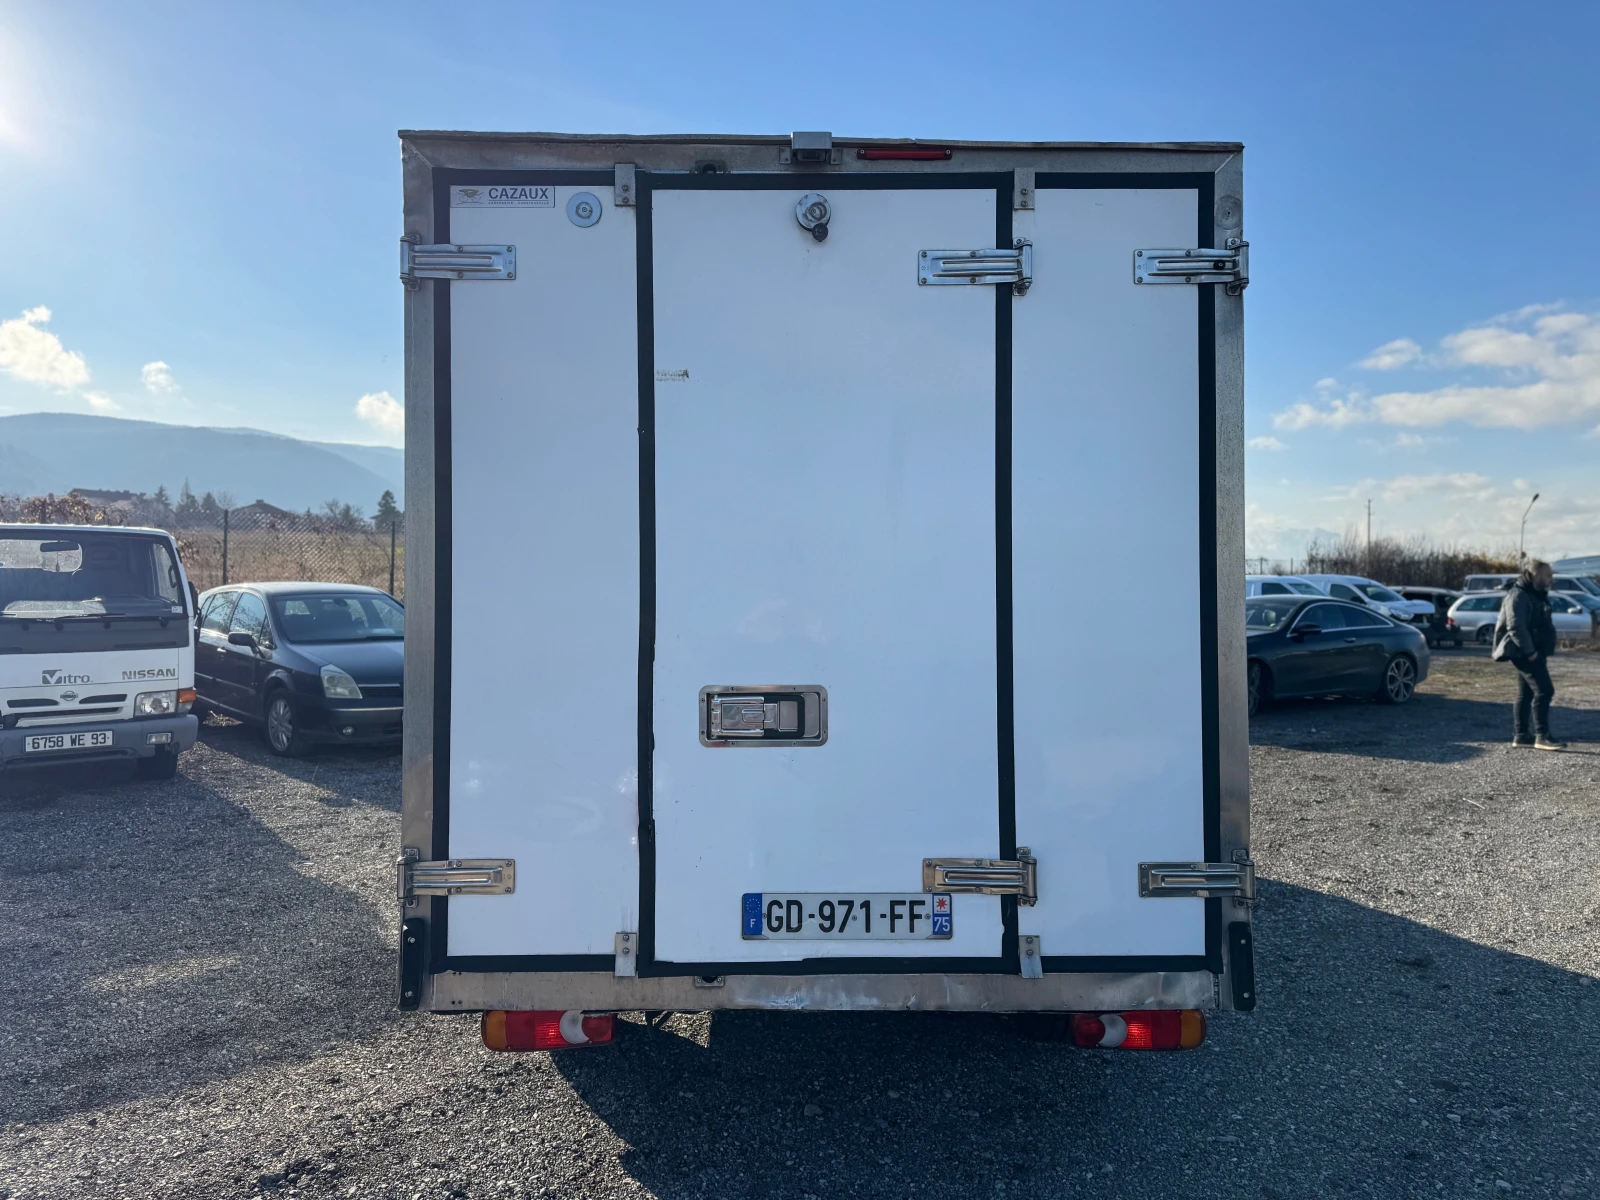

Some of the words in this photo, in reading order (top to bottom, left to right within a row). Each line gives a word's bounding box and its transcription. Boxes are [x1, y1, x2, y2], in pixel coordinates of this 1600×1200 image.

[488, 187, 549, 200] CAZAUX
[42, 669, 91, 684] Vitro
[121, 668, 176, 680] NISSAN
[31, 735, 64, 750] 6758
[70, 733, 86, 747] WE
[91, 732, 107, 745] 93
[750, 918, 756, 928] F
[766, 899, 926, 933] GD-971-FF
[934, 916, 950, 932] 75
